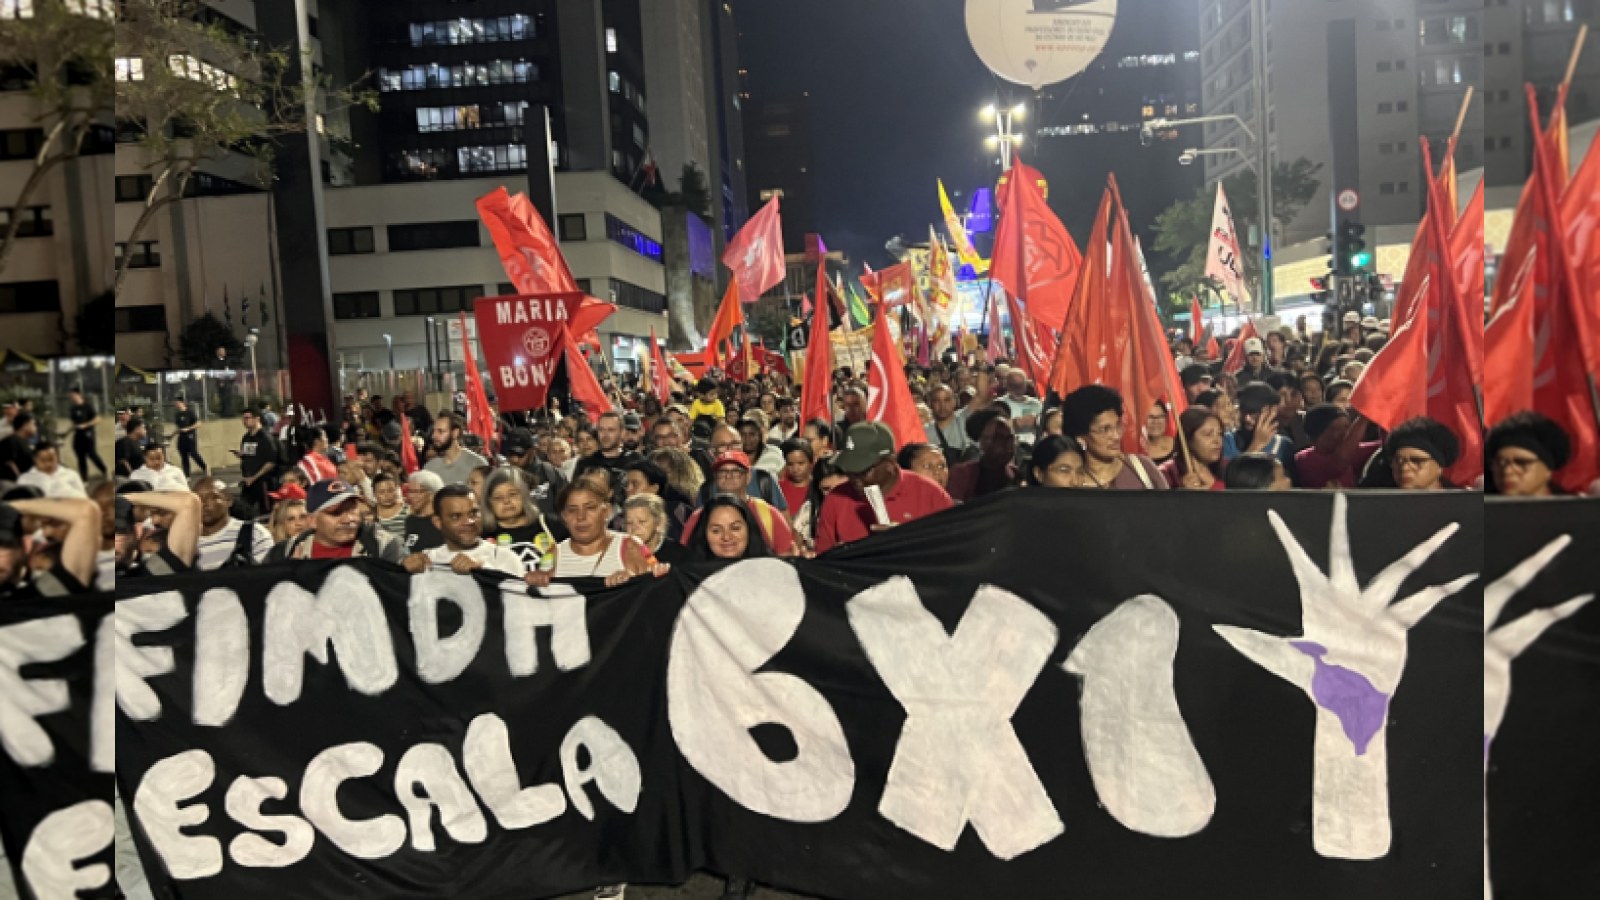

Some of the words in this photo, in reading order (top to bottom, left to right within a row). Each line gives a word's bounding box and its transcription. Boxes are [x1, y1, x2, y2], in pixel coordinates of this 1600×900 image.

[495, 299, 568, 324] MARIA
[667, 557, 1216, 861] 6X1
[134, 712, 642, 880] ESCALA
